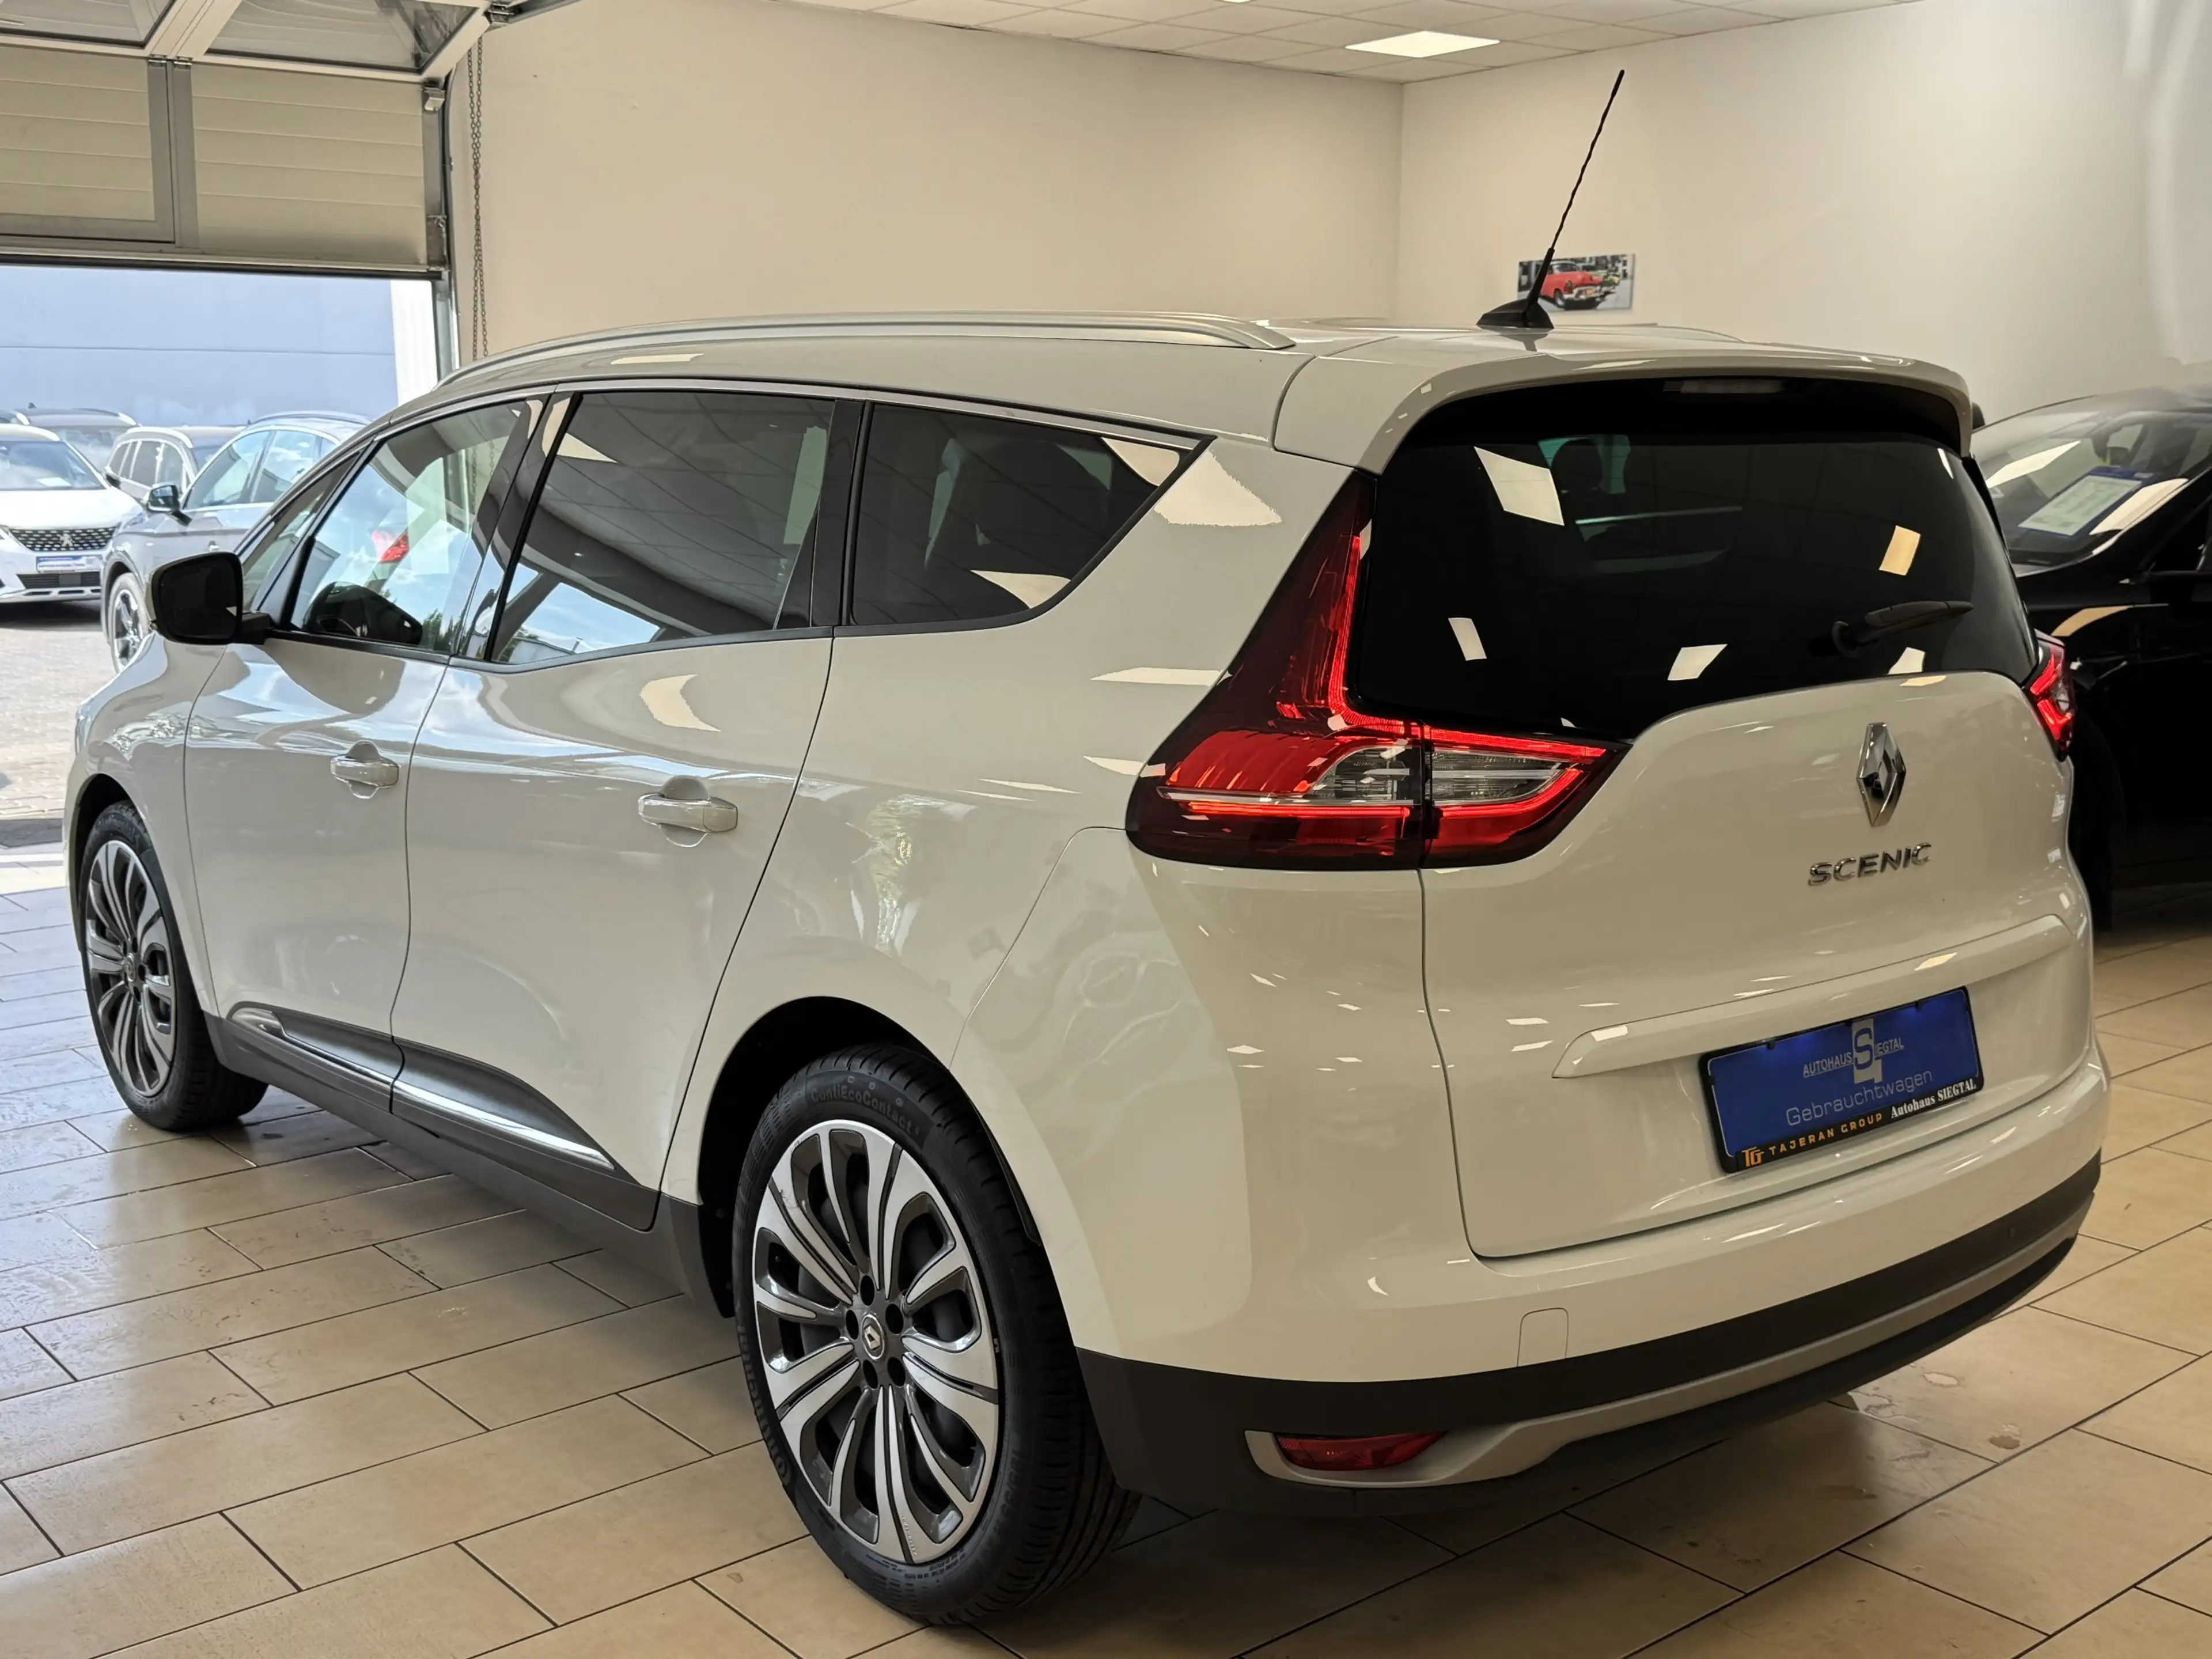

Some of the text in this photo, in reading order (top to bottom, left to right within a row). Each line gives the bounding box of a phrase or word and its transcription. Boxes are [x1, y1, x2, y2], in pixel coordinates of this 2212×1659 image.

[1808, 842, 1932, 887] SCENIC
[1804, 1051, 1853, 1078] AUTOHAUS
[1786, 1070, 1933, 1126] Gebrauchtwagen
[1891, 1078, 1977, 1119] Autohaus SIEGTAL
[1768, 1128, 1835, 1156] TAJERAN
[1840, 1112, 1883, 1134] GROUP
